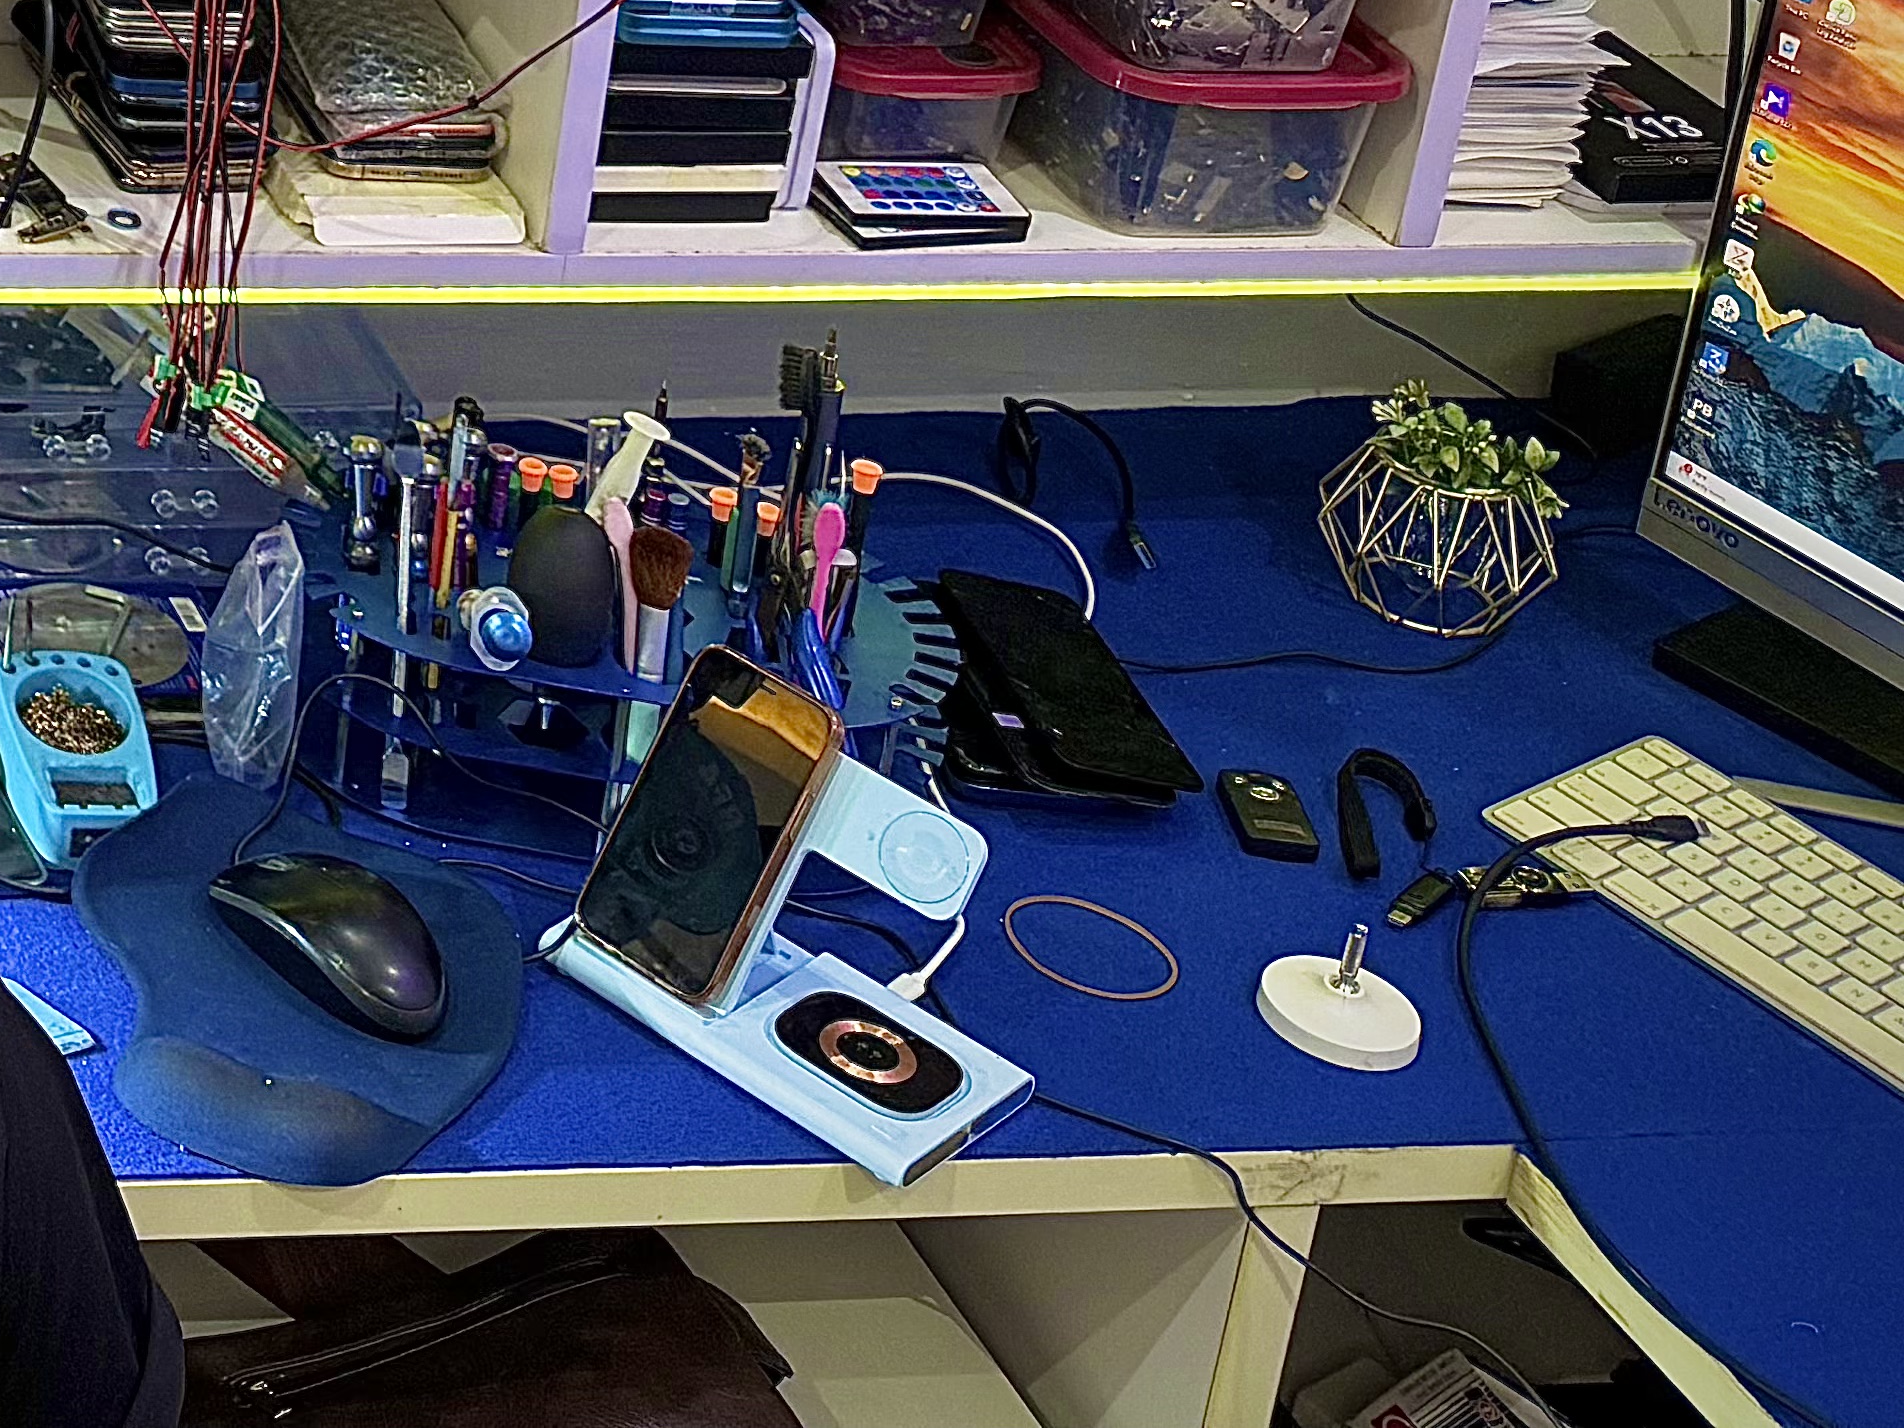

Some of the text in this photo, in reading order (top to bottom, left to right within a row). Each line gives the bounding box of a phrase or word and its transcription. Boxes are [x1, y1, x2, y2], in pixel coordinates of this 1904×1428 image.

[1603, 117, 1703, 140] X13
[1693, 397, 1713, 418] PB
[1654, 490, 1739, 548] Lenovo
